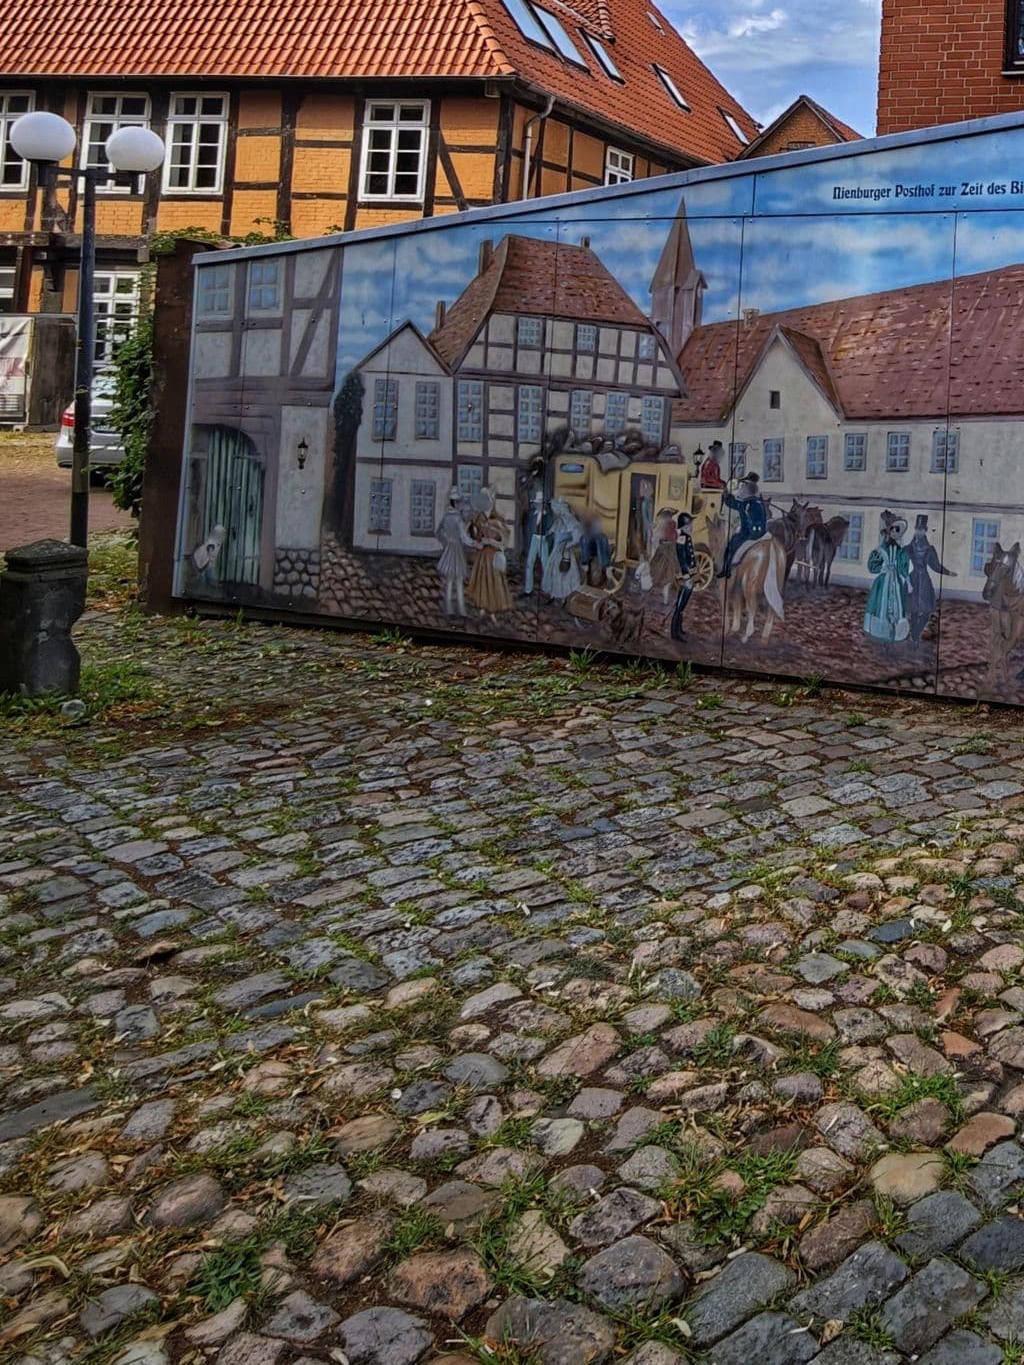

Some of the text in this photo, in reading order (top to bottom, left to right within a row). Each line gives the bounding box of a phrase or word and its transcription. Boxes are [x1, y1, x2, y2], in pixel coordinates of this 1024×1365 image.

[832, 186, 892, 201] Nienburger
[895, 183, 936, 198] Posthof
[938, 186, 958, 196] zur
[960, 182, 984, 196] Zeit
[987, 181, 1007, 195] des
